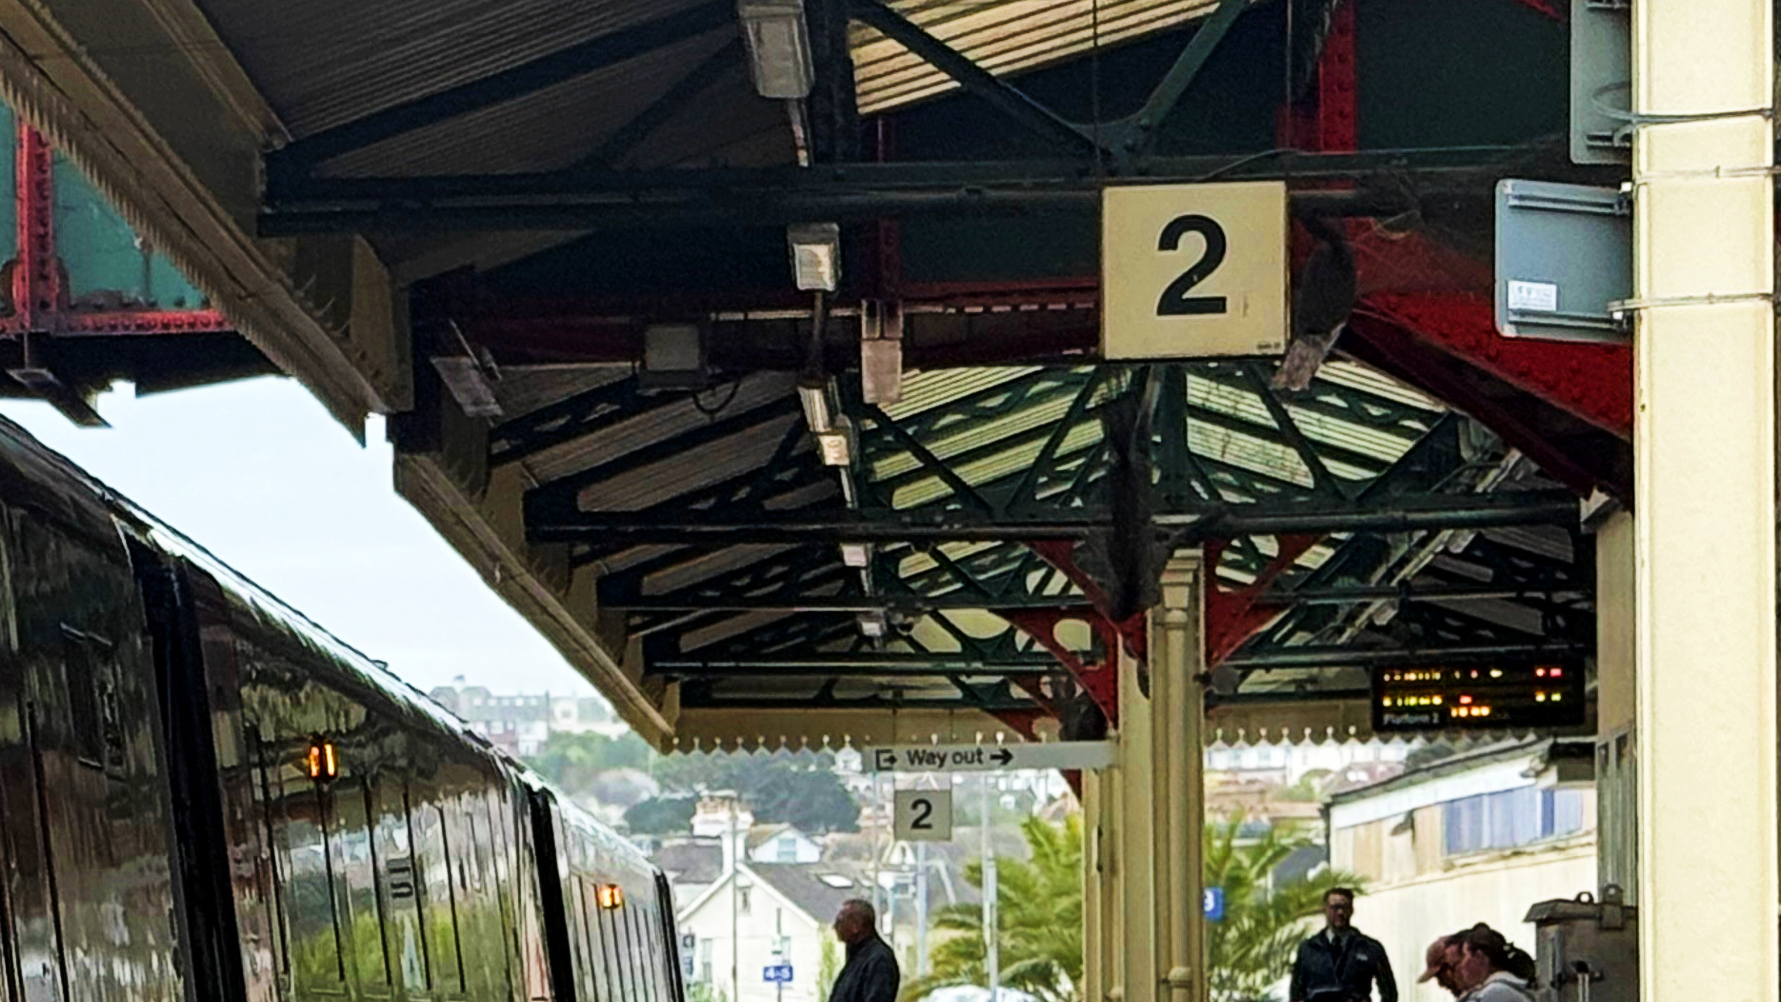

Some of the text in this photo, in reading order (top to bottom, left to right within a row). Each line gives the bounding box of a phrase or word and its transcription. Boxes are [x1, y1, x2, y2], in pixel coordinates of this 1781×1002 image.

[1155, 213, 1228, 317] 2
[906, 748, 984, 769] Way out
[910, 798, 933, 830] 2
